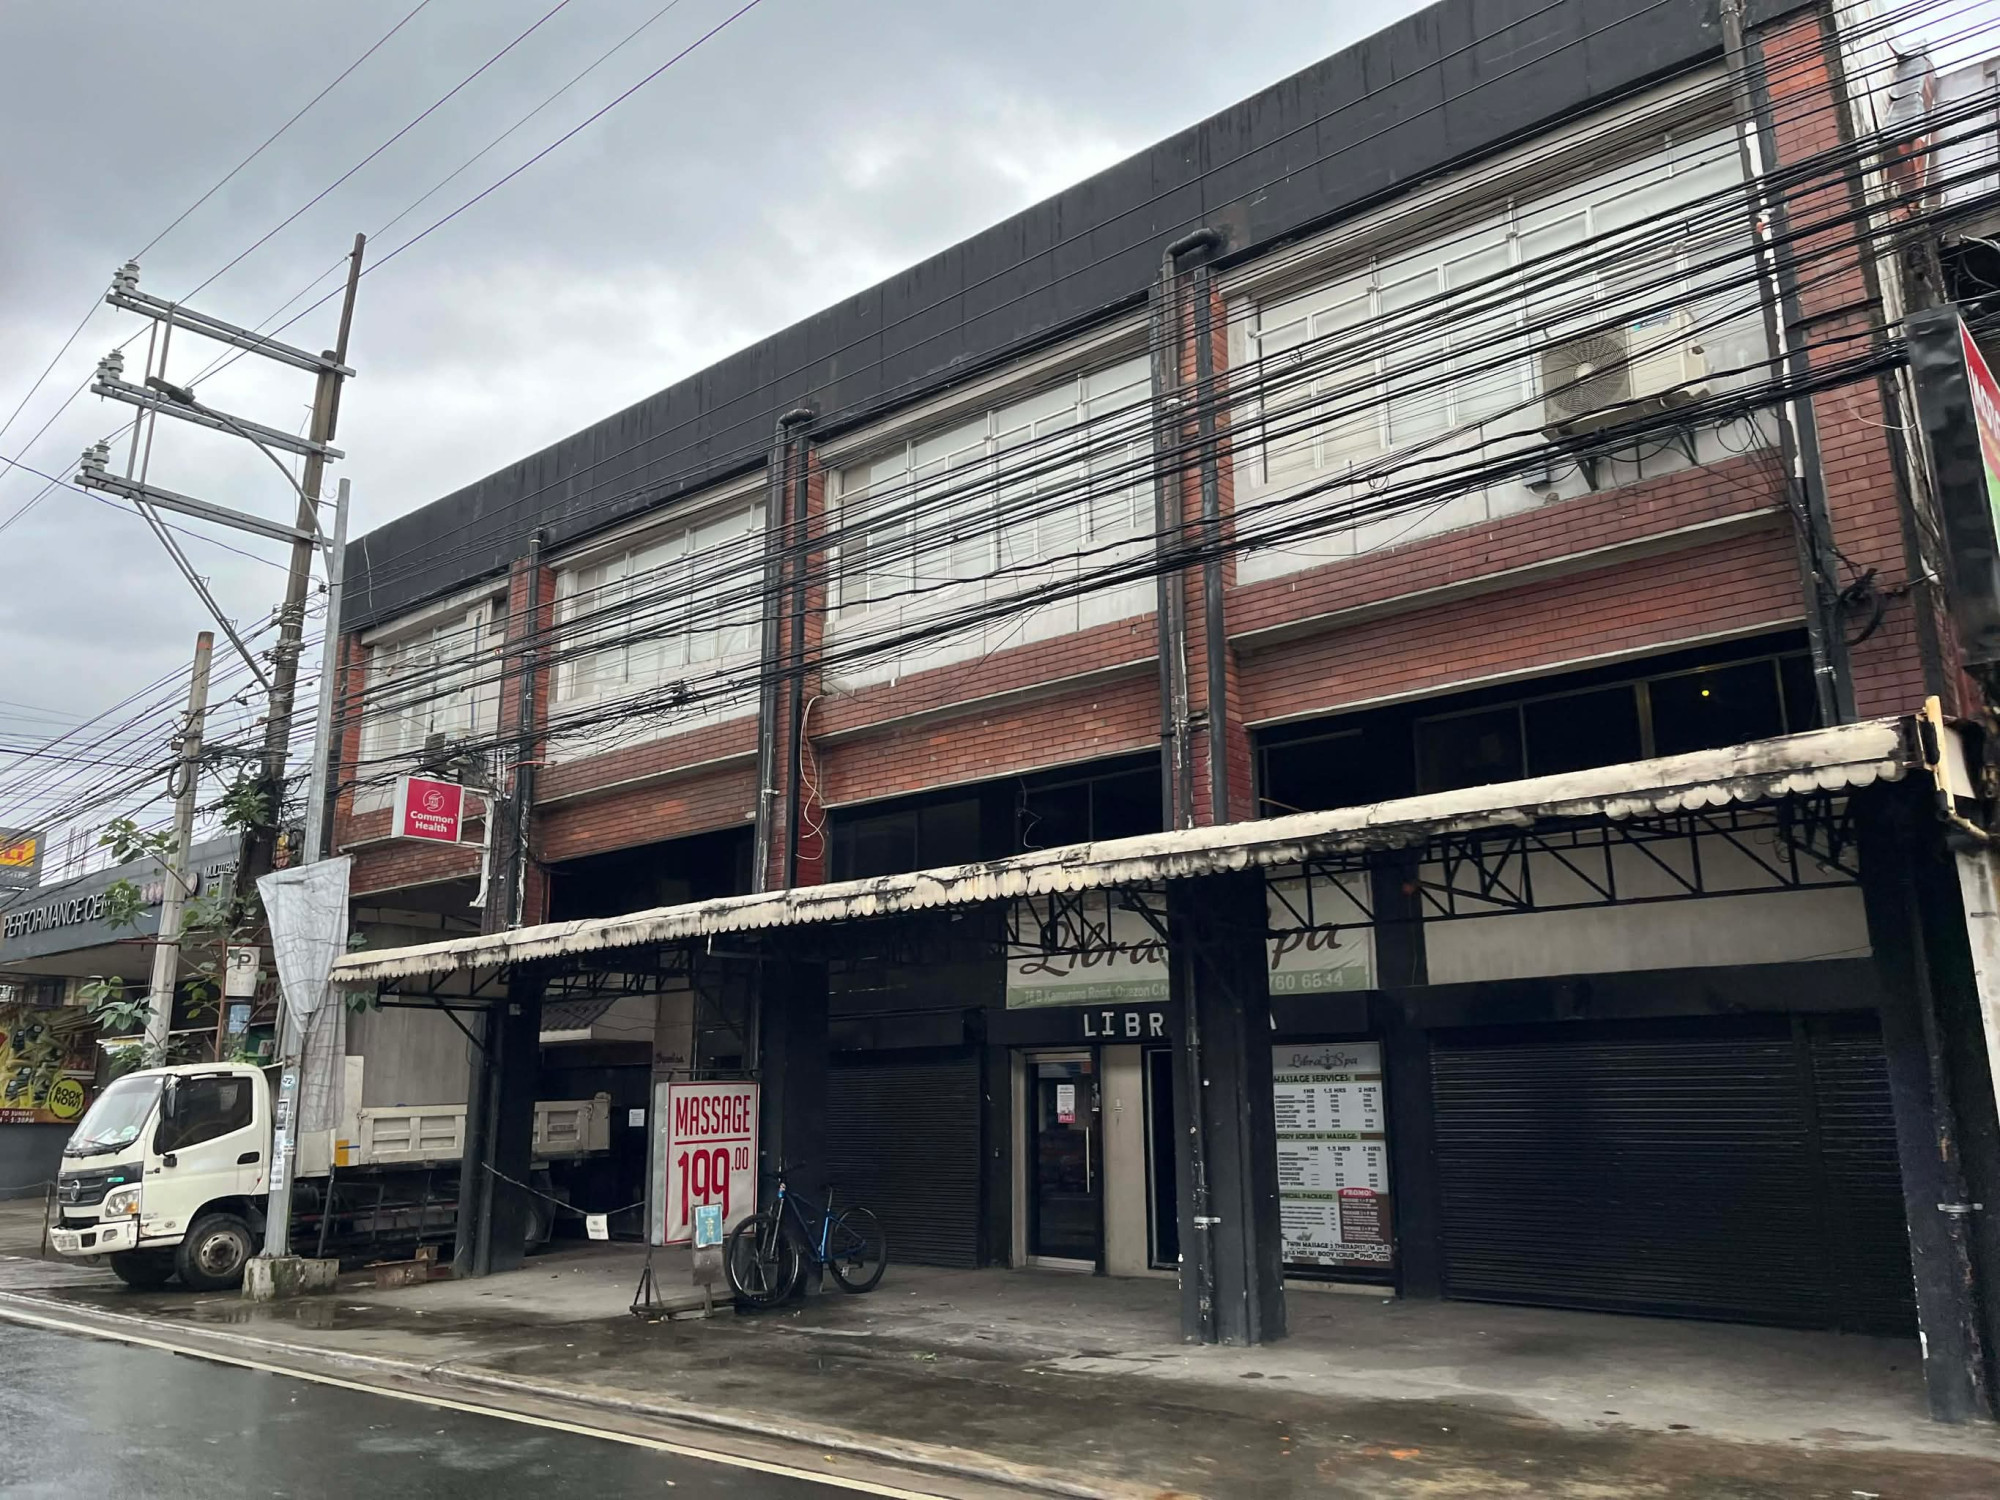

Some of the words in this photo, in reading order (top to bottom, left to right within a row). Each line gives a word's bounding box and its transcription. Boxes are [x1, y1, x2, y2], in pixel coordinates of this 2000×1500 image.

[410, 810, 454, 824] Common
[415, 821, 447, 833] Health
[3, 898, 84, 938] PERFORMANCE
[236, 953, 252, 970] P
[1083, 1011, 1165, 1038] LIBR
[1288, 1053, 1323, 1068] Libra
[1334, 1051, 1359, 1068] Spa
[55, 1086, 83, 1099] BOOK
[53, 1096, 81, 1110] NOW!
[675, 1095, 751, 1136] MASSAGE
